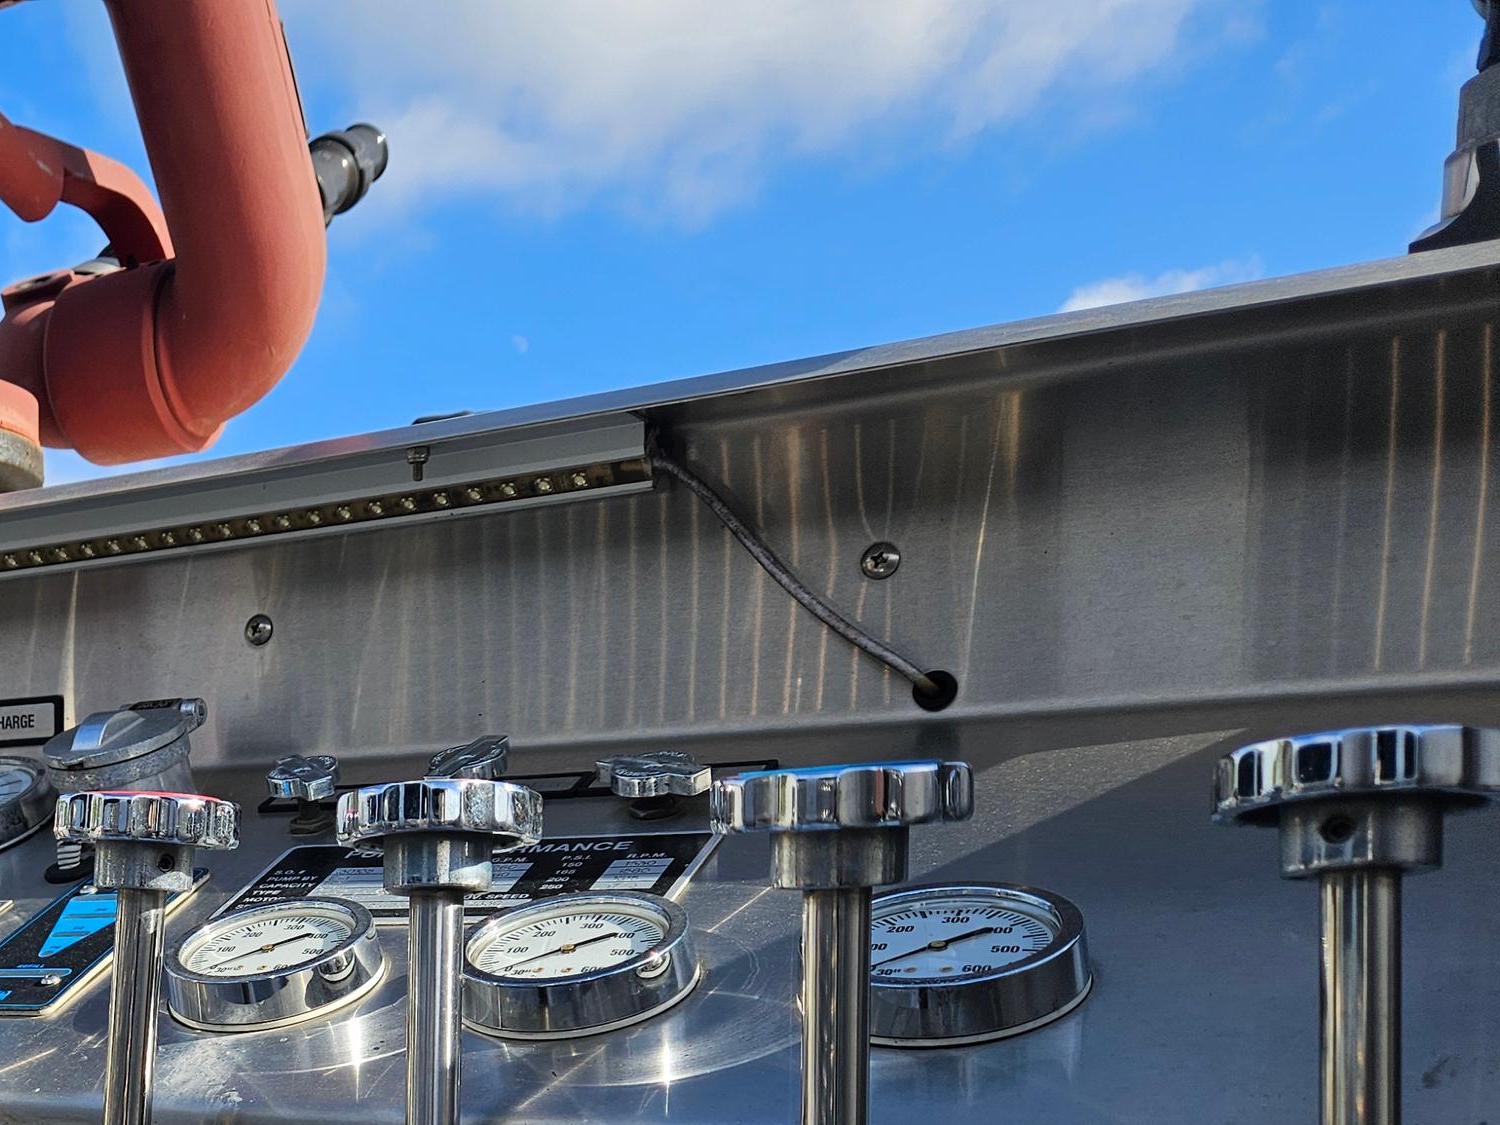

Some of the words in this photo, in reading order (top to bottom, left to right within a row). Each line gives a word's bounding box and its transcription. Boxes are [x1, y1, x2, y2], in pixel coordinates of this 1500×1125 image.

[941, 916, 970, 924] 300
[283, 923, 305, 931] 300
[580, 922, 604, 930] 300
[886, 925, 915, 933] 200
[532, 930, 556, 938] 200
[216, 945, 237, 953] 100
[506, 946, 529, 954] 100
[990, 945, 1021, 953] 500
